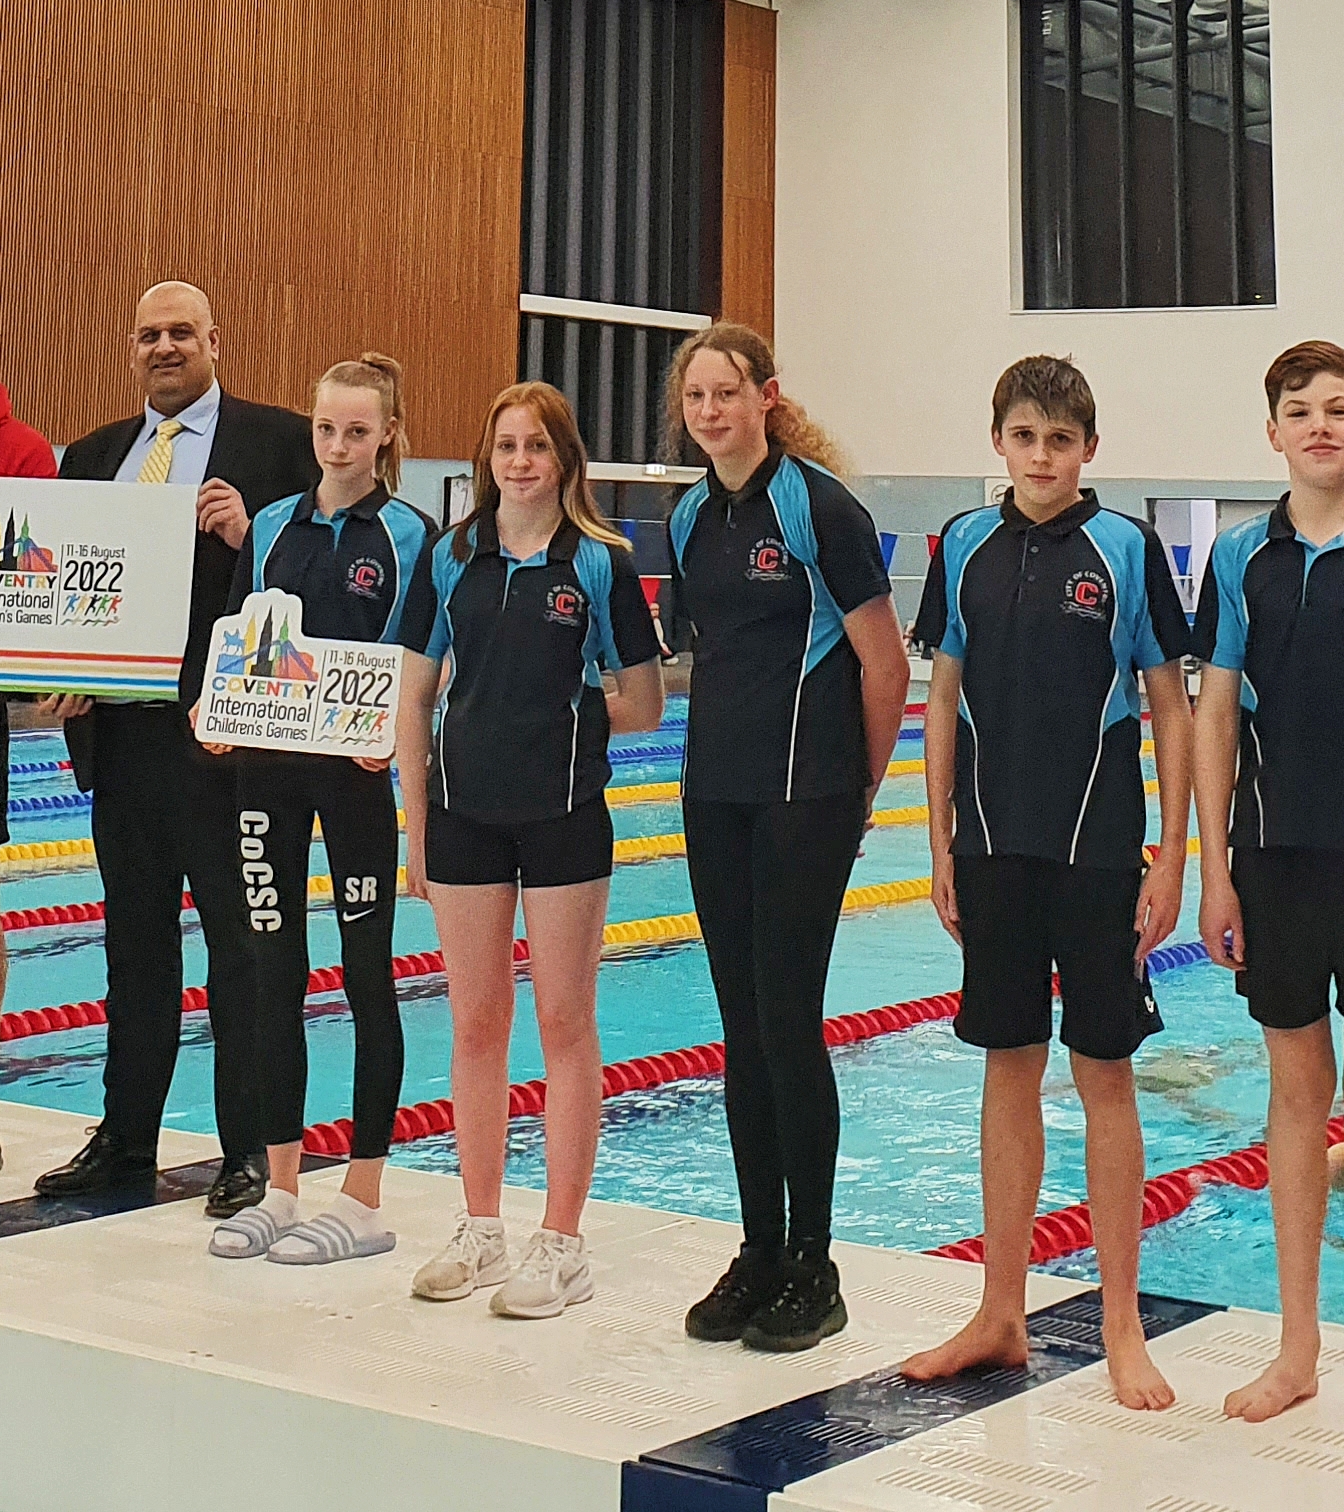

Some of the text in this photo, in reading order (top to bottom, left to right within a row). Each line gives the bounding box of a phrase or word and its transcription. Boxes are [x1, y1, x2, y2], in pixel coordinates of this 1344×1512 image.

[67, 544, 126, 561] 11-16 August
[757, 548, 779, 570] C
[63, 560, 123, 592] 2022
[355, 565, 376, 586] C
[555, 593, 576, 615] C
[1074, 581, 1099, 605] C
[16, 609, 52, 625] Games
[329, 650, 397, 670] 11-16 August
[211, 676, 317, 700] COVENTRY
[322, 669, 394, 708] 2022
[209, 693, 312, 723] International
[206, 715, 308, 741] Children's Games
[239, 810, 283, 933] CoCSC
[345, 876, 377, 903] SR
